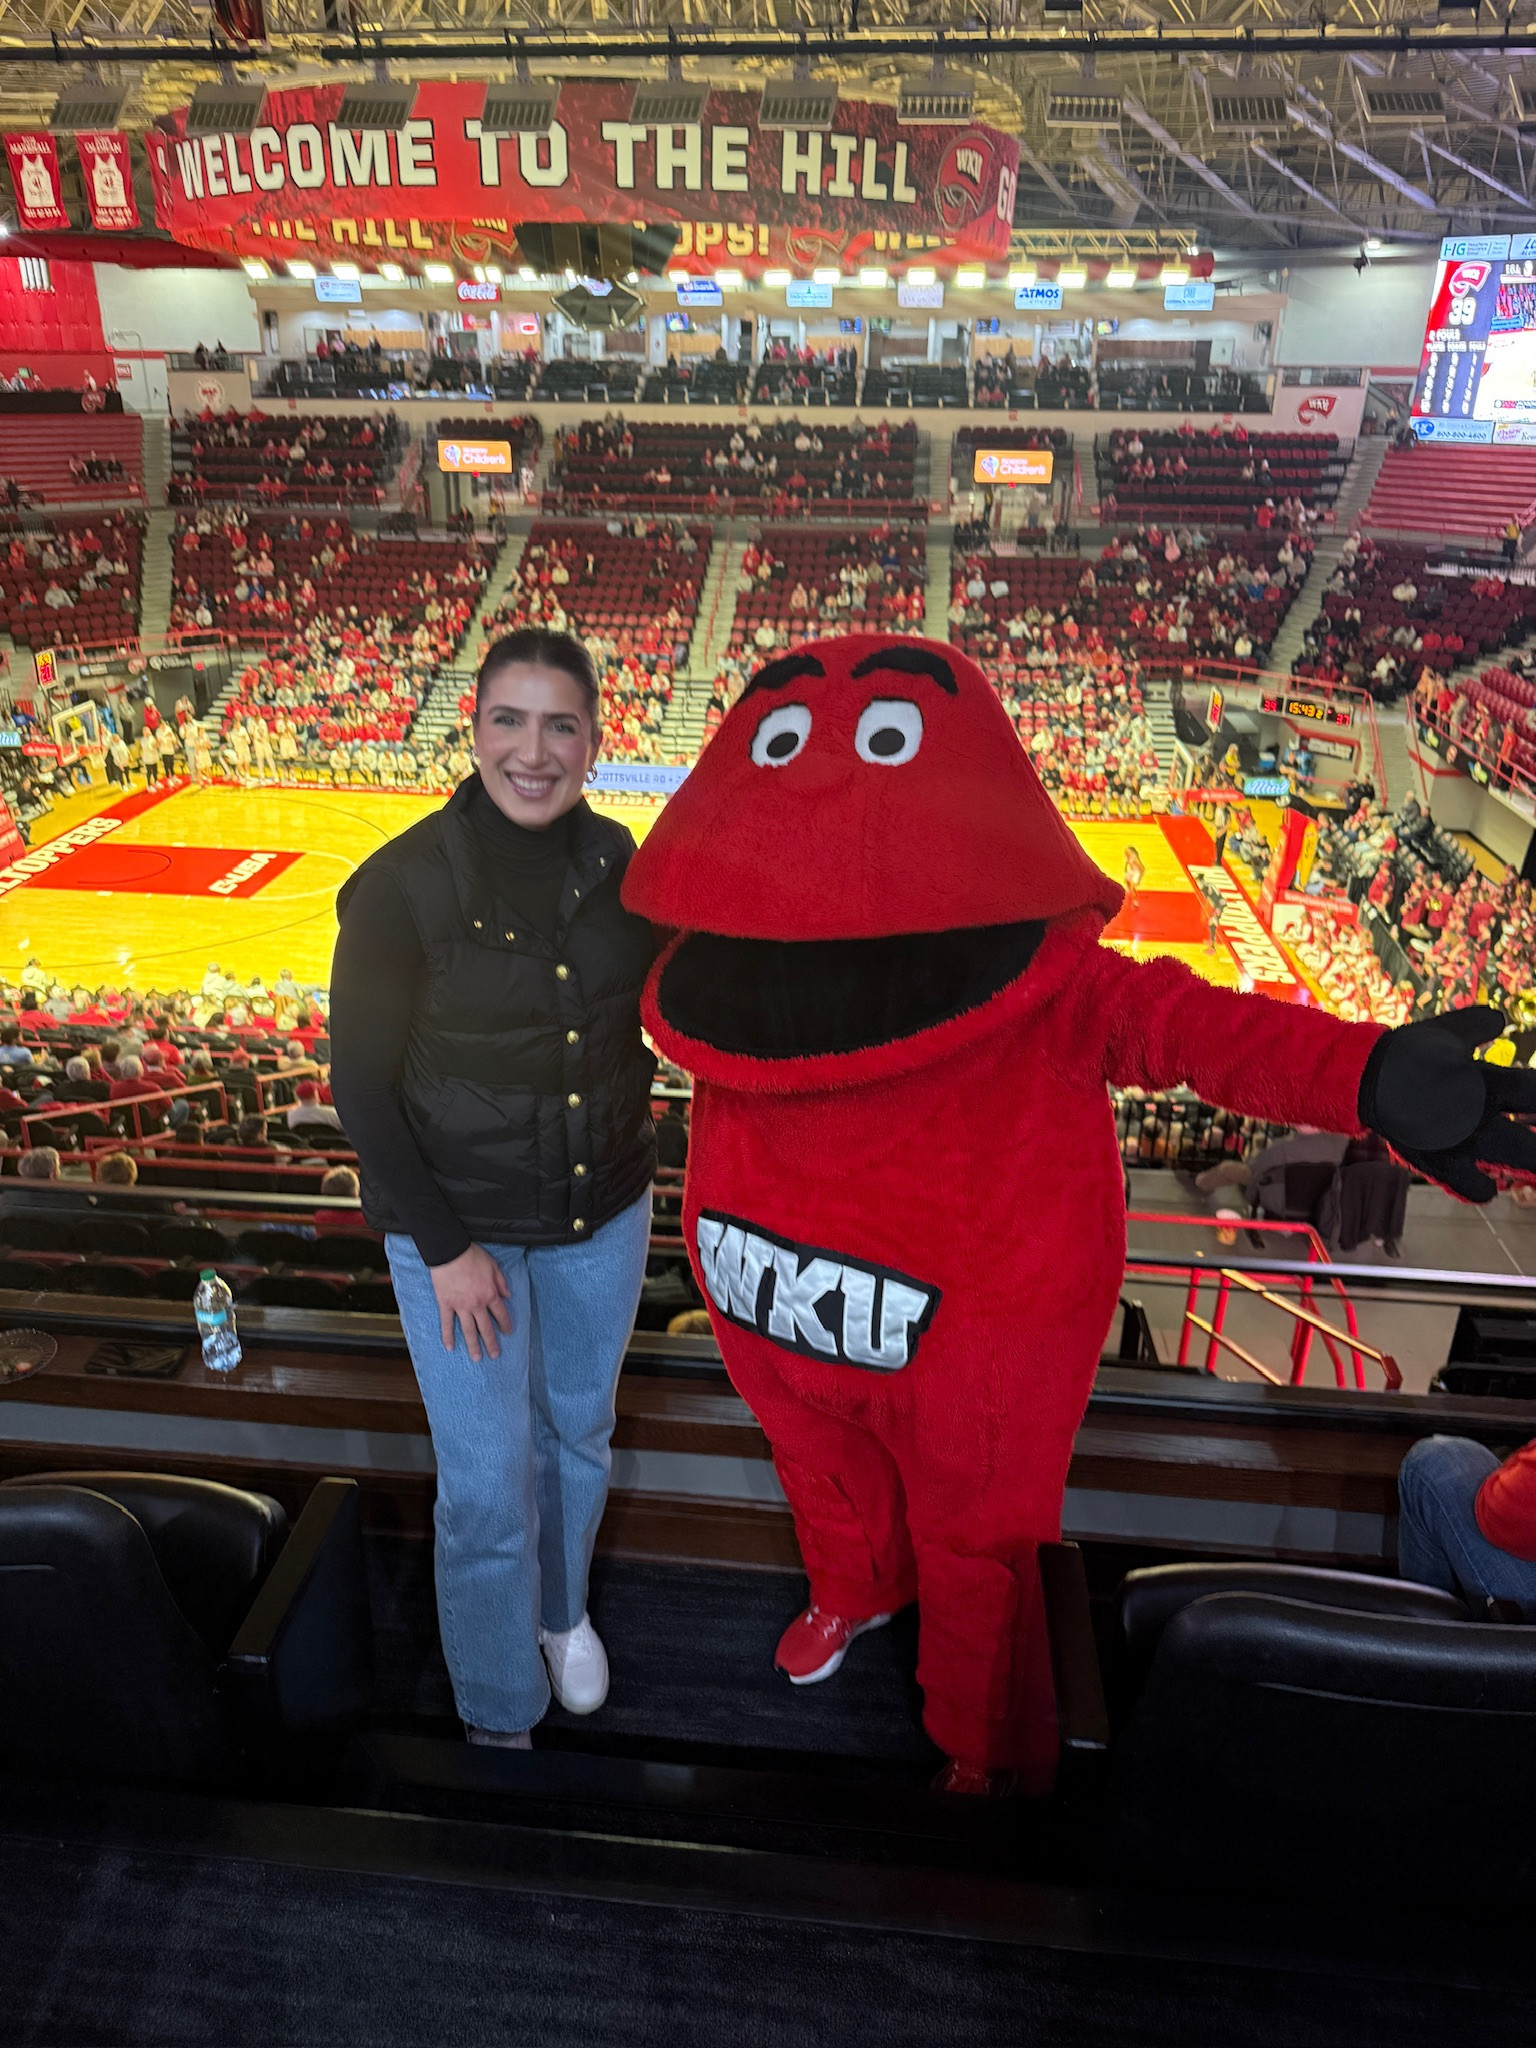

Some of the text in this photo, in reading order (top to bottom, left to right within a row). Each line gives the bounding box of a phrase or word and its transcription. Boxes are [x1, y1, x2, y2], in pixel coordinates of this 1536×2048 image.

[175, 120, 438, 200] WELCOME
[465, 119, 569, 187] TO
[602, 122, 749, 191] THE
[782, 130, 917, 203] HILL
[956, 147, 984, 184] WKU
[1019, 288, 1059, 298] ATMOS
[1449, 297, 1476, 325] 39
[1263, 700, 1277, 713] 39
[1289, 702, 1316, 717] 15:43
[1336, 713, 1350, 726] 37
[599, 773, 650, 783] COTTSVILLE
[0, 817, 123, 896] LTOPPERS
[697, 1216, 929, 1369] WKU
